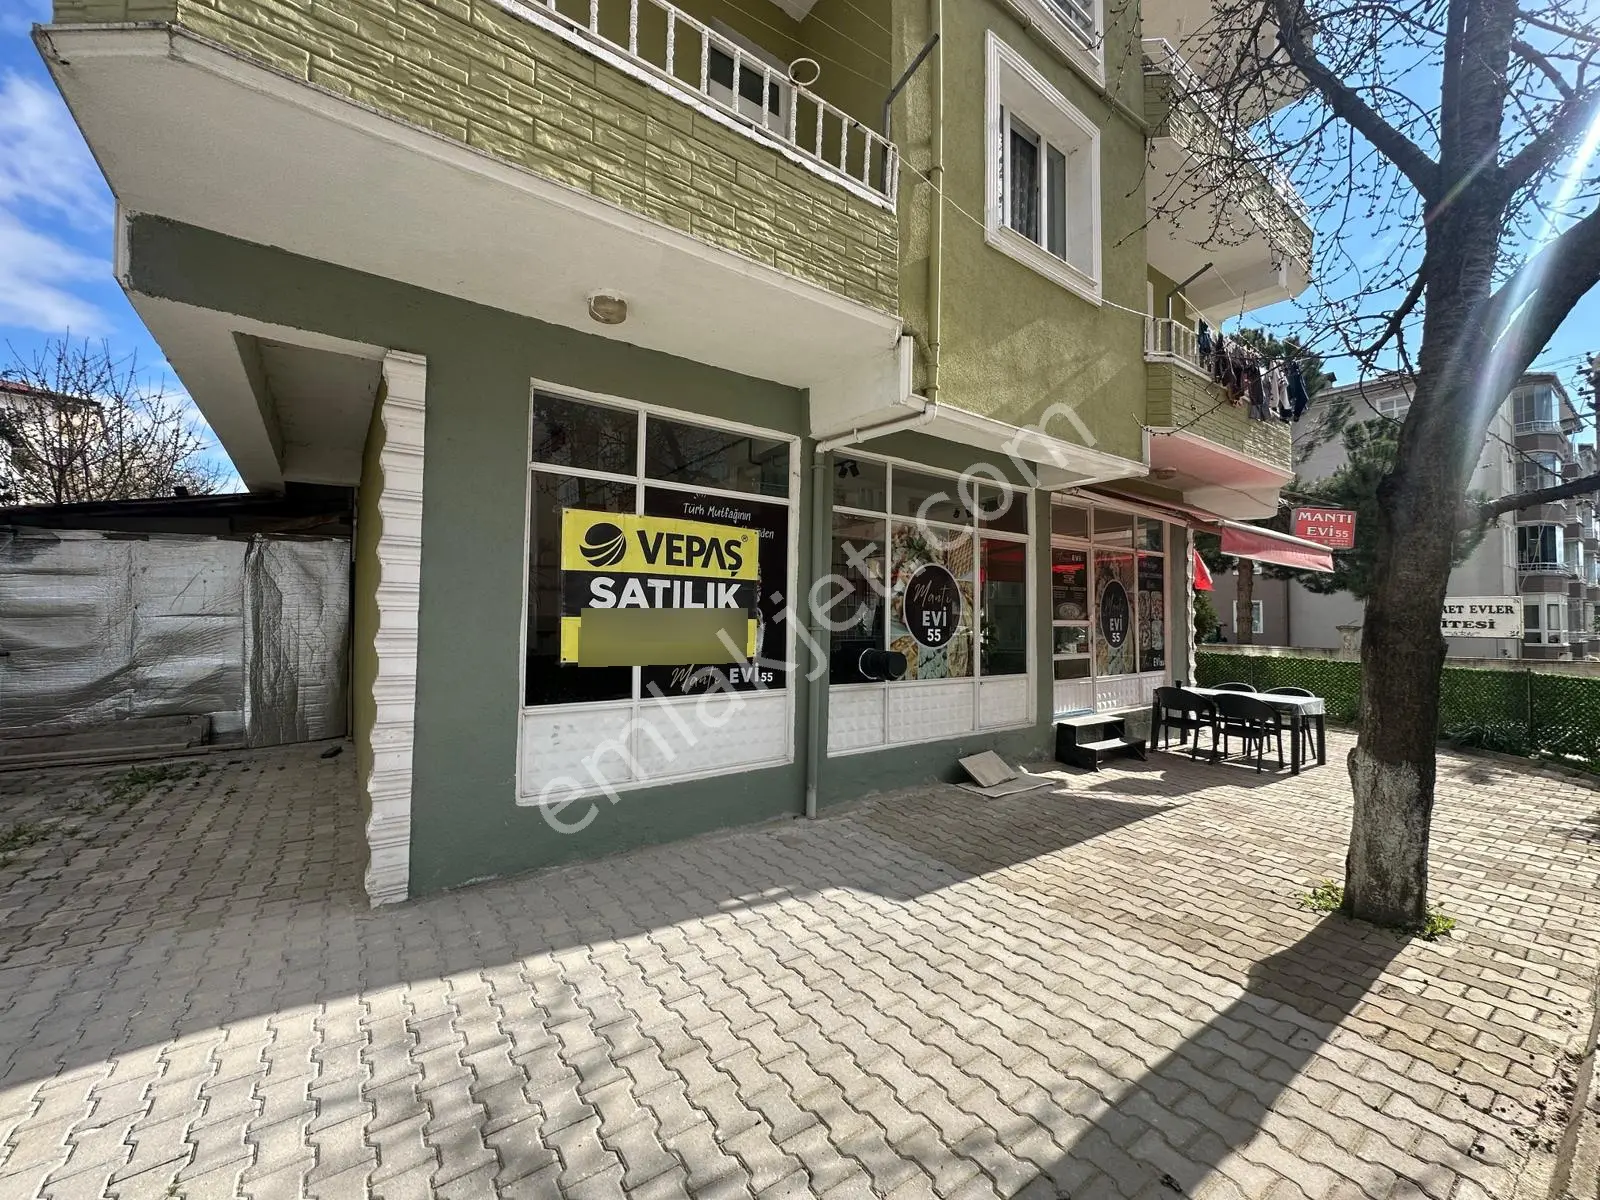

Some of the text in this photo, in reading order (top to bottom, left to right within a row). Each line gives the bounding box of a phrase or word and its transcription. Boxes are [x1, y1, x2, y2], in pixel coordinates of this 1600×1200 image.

[683, 502, 705, 515] Türk
[1298, 511, 1352, 524] MANTI
[636, 529, 743, 577] VEPAŞ
[588, 576, 741, 609] SATILIK
[1442, 605, 1515, 614] RET EVLER
[922, 606, 947, 627] EVİ
[1109, 615, 1123, 632] EVİ
[1441, 618, 1496, 629] İTESİ
[927, 628, 941, 642] 55
[1112, 632, 1121, 643] 55
